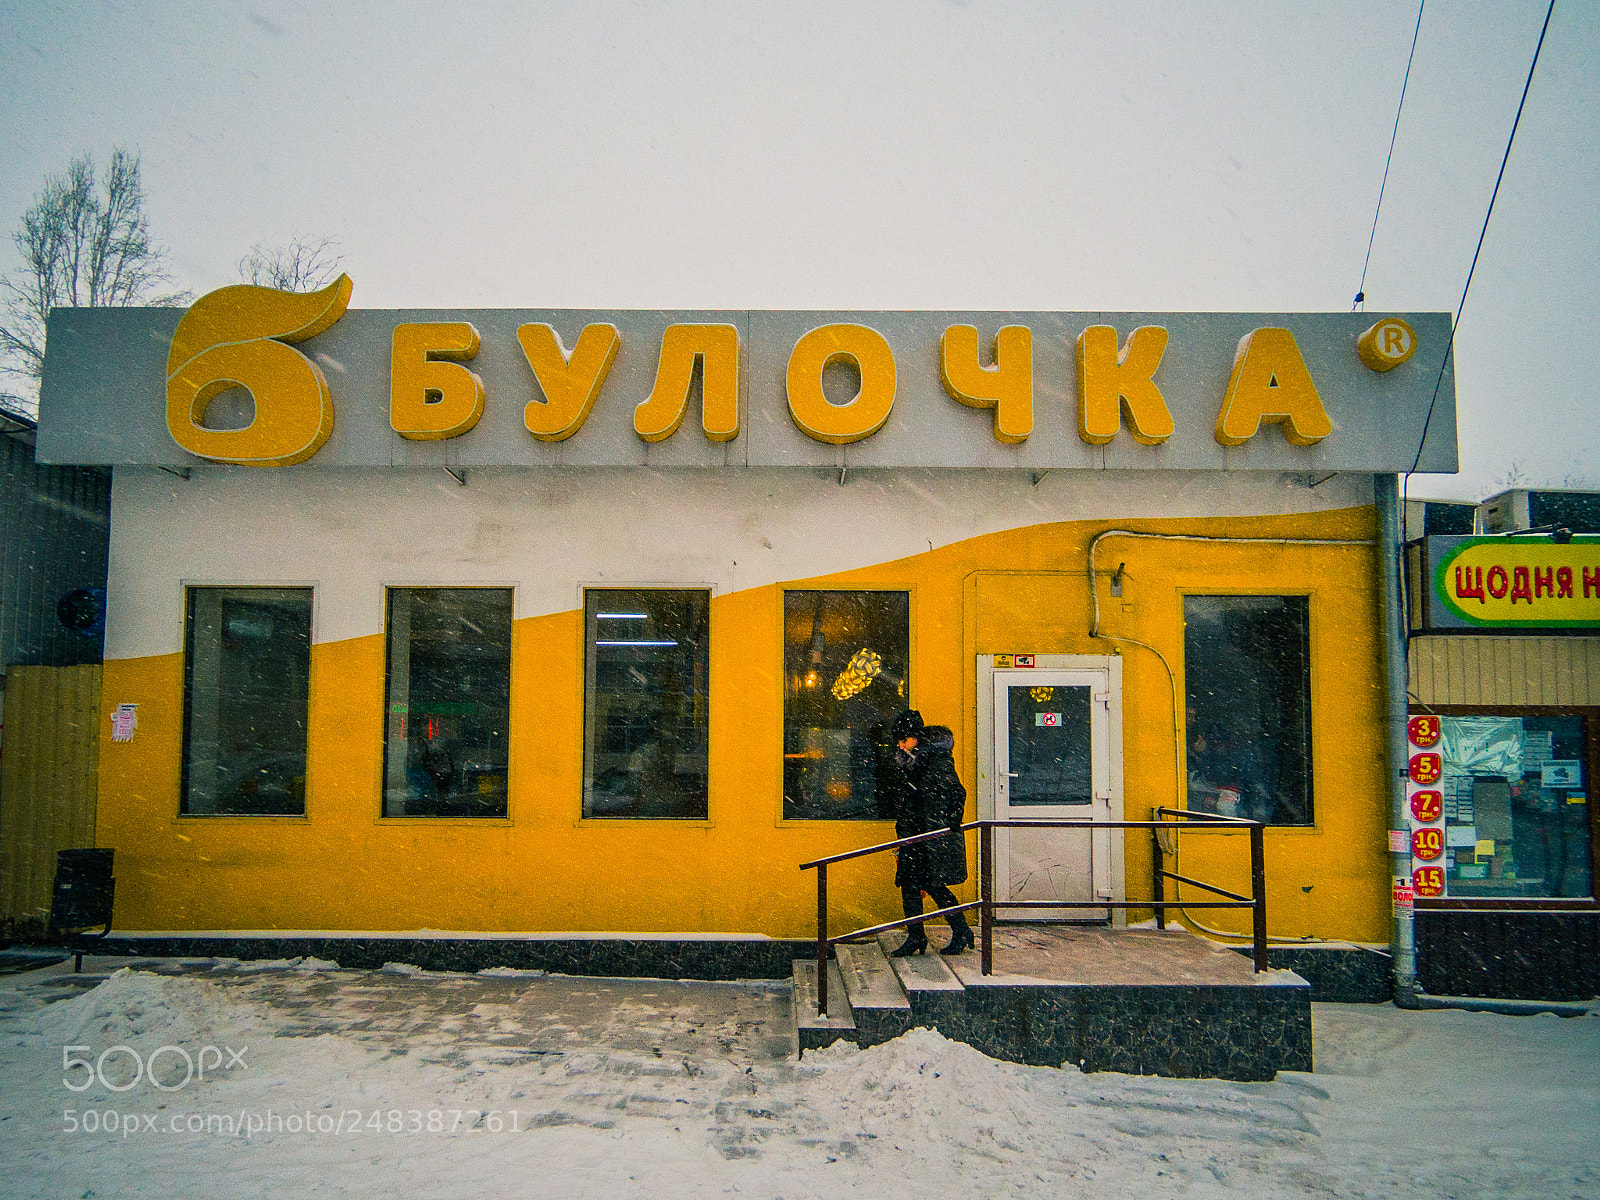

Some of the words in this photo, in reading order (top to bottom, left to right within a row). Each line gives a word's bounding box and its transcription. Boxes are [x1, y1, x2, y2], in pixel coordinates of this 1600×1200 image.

[389, 321, 1332, 445] БУЛОЧКА
[1455, 565, 1573, 605] ЩОДНЯ
[1418, 719, 1431, 736] 3
[1419, 756, 1432, 774] 5
[1420, 794, 1433, 811] 7
[1416, 832, 1439, 849] 10
[1418, 870, 1440, 887] 15
